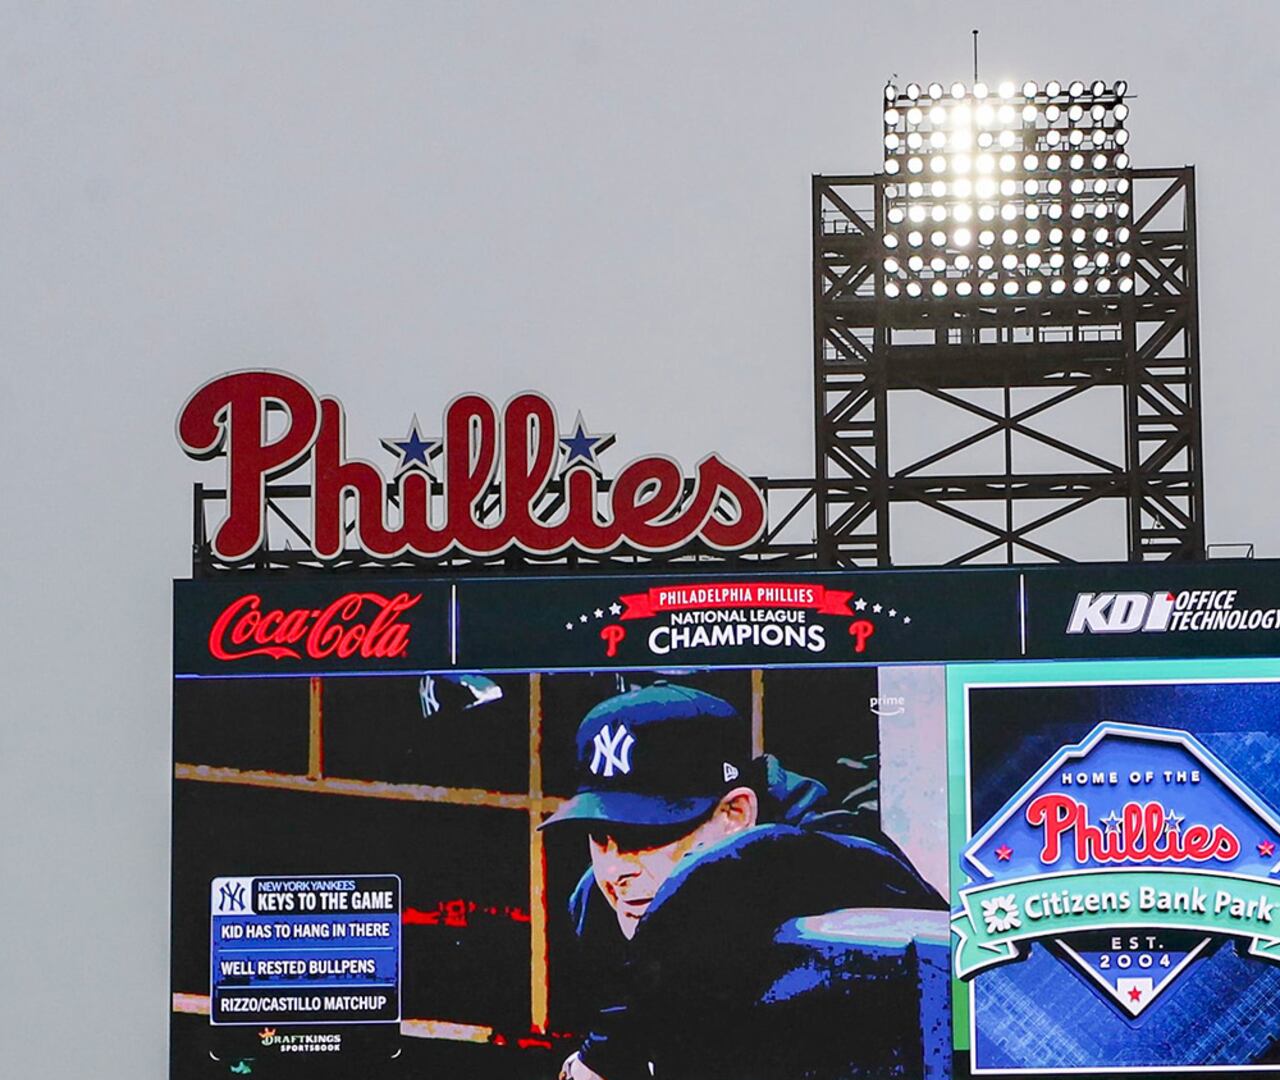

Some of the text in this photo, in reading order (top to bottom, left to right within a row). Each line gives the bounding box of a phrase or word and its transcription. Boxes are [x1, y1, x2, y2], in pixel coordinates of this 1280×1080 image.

[176, 368, 766, 563] Phillies
[659, 587, 815, 606] PHILADELPHIA PHILLIES
[1174, 589, 1238, 611] OFFICE
[670, 609, 806, 626] NATIONAL LEAGUE
[1065, 591, 1175, 635] KDI
[209, 591, 422, 661] Coca-Cola
[648, 622, 826, 655] CHAMPIONS
[869, 696, 905, 707] prime
[1061, 770, 1201, 785] HOME OF THE
[1026, 793, 1240, 864] Phillies
[258, 880, 356, 892] NEW YORK YANKEES
[258, 890, 393, 911] KEYS TO THE GAME
[1024, 886, 1276, 922] Citizens Bank Park
[221, 923, 390, 939] KID HAS TO HANG IN THERE
[1111, 936, 1164, 950] EST.
[221, 959, 375, 976] WELL RESTED BULLPENS
[1100, 954, 1171, 969] 2004
[220, 995, 387, 1012] RIZZO/CASTILLO MATCHUP
[261, 1033, 341, 1046] DRAFTKINGS
[280, 1044, 341, 1052] SPORTSBOOK
